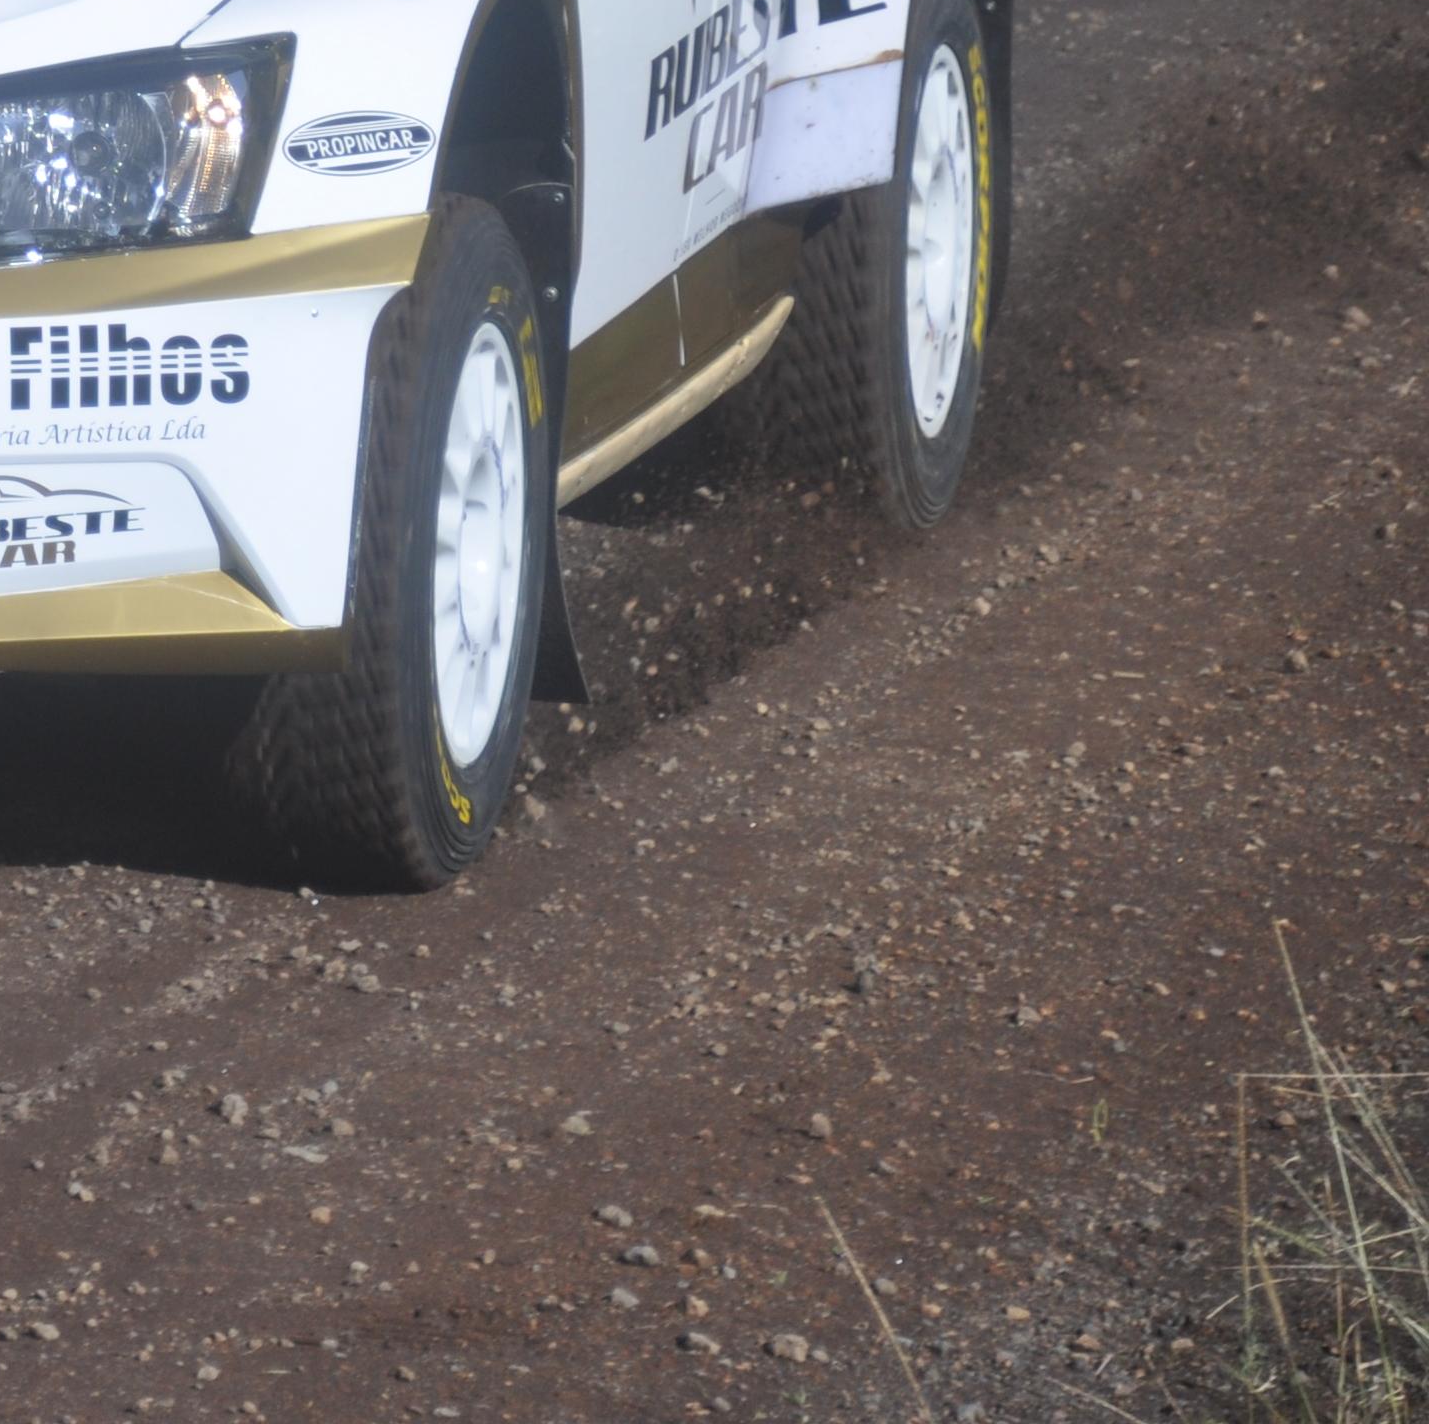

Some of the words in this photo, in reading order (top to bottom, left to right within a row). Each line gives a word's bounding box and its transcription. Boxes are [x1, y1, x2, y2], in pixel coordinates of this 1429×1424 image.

[306, 129, 415, 159] PROPINCAR
[682, 60, 768, 195] CAR
[9, 323, 251, 411] Filhos
[159, 415, 207, 442] Lda
